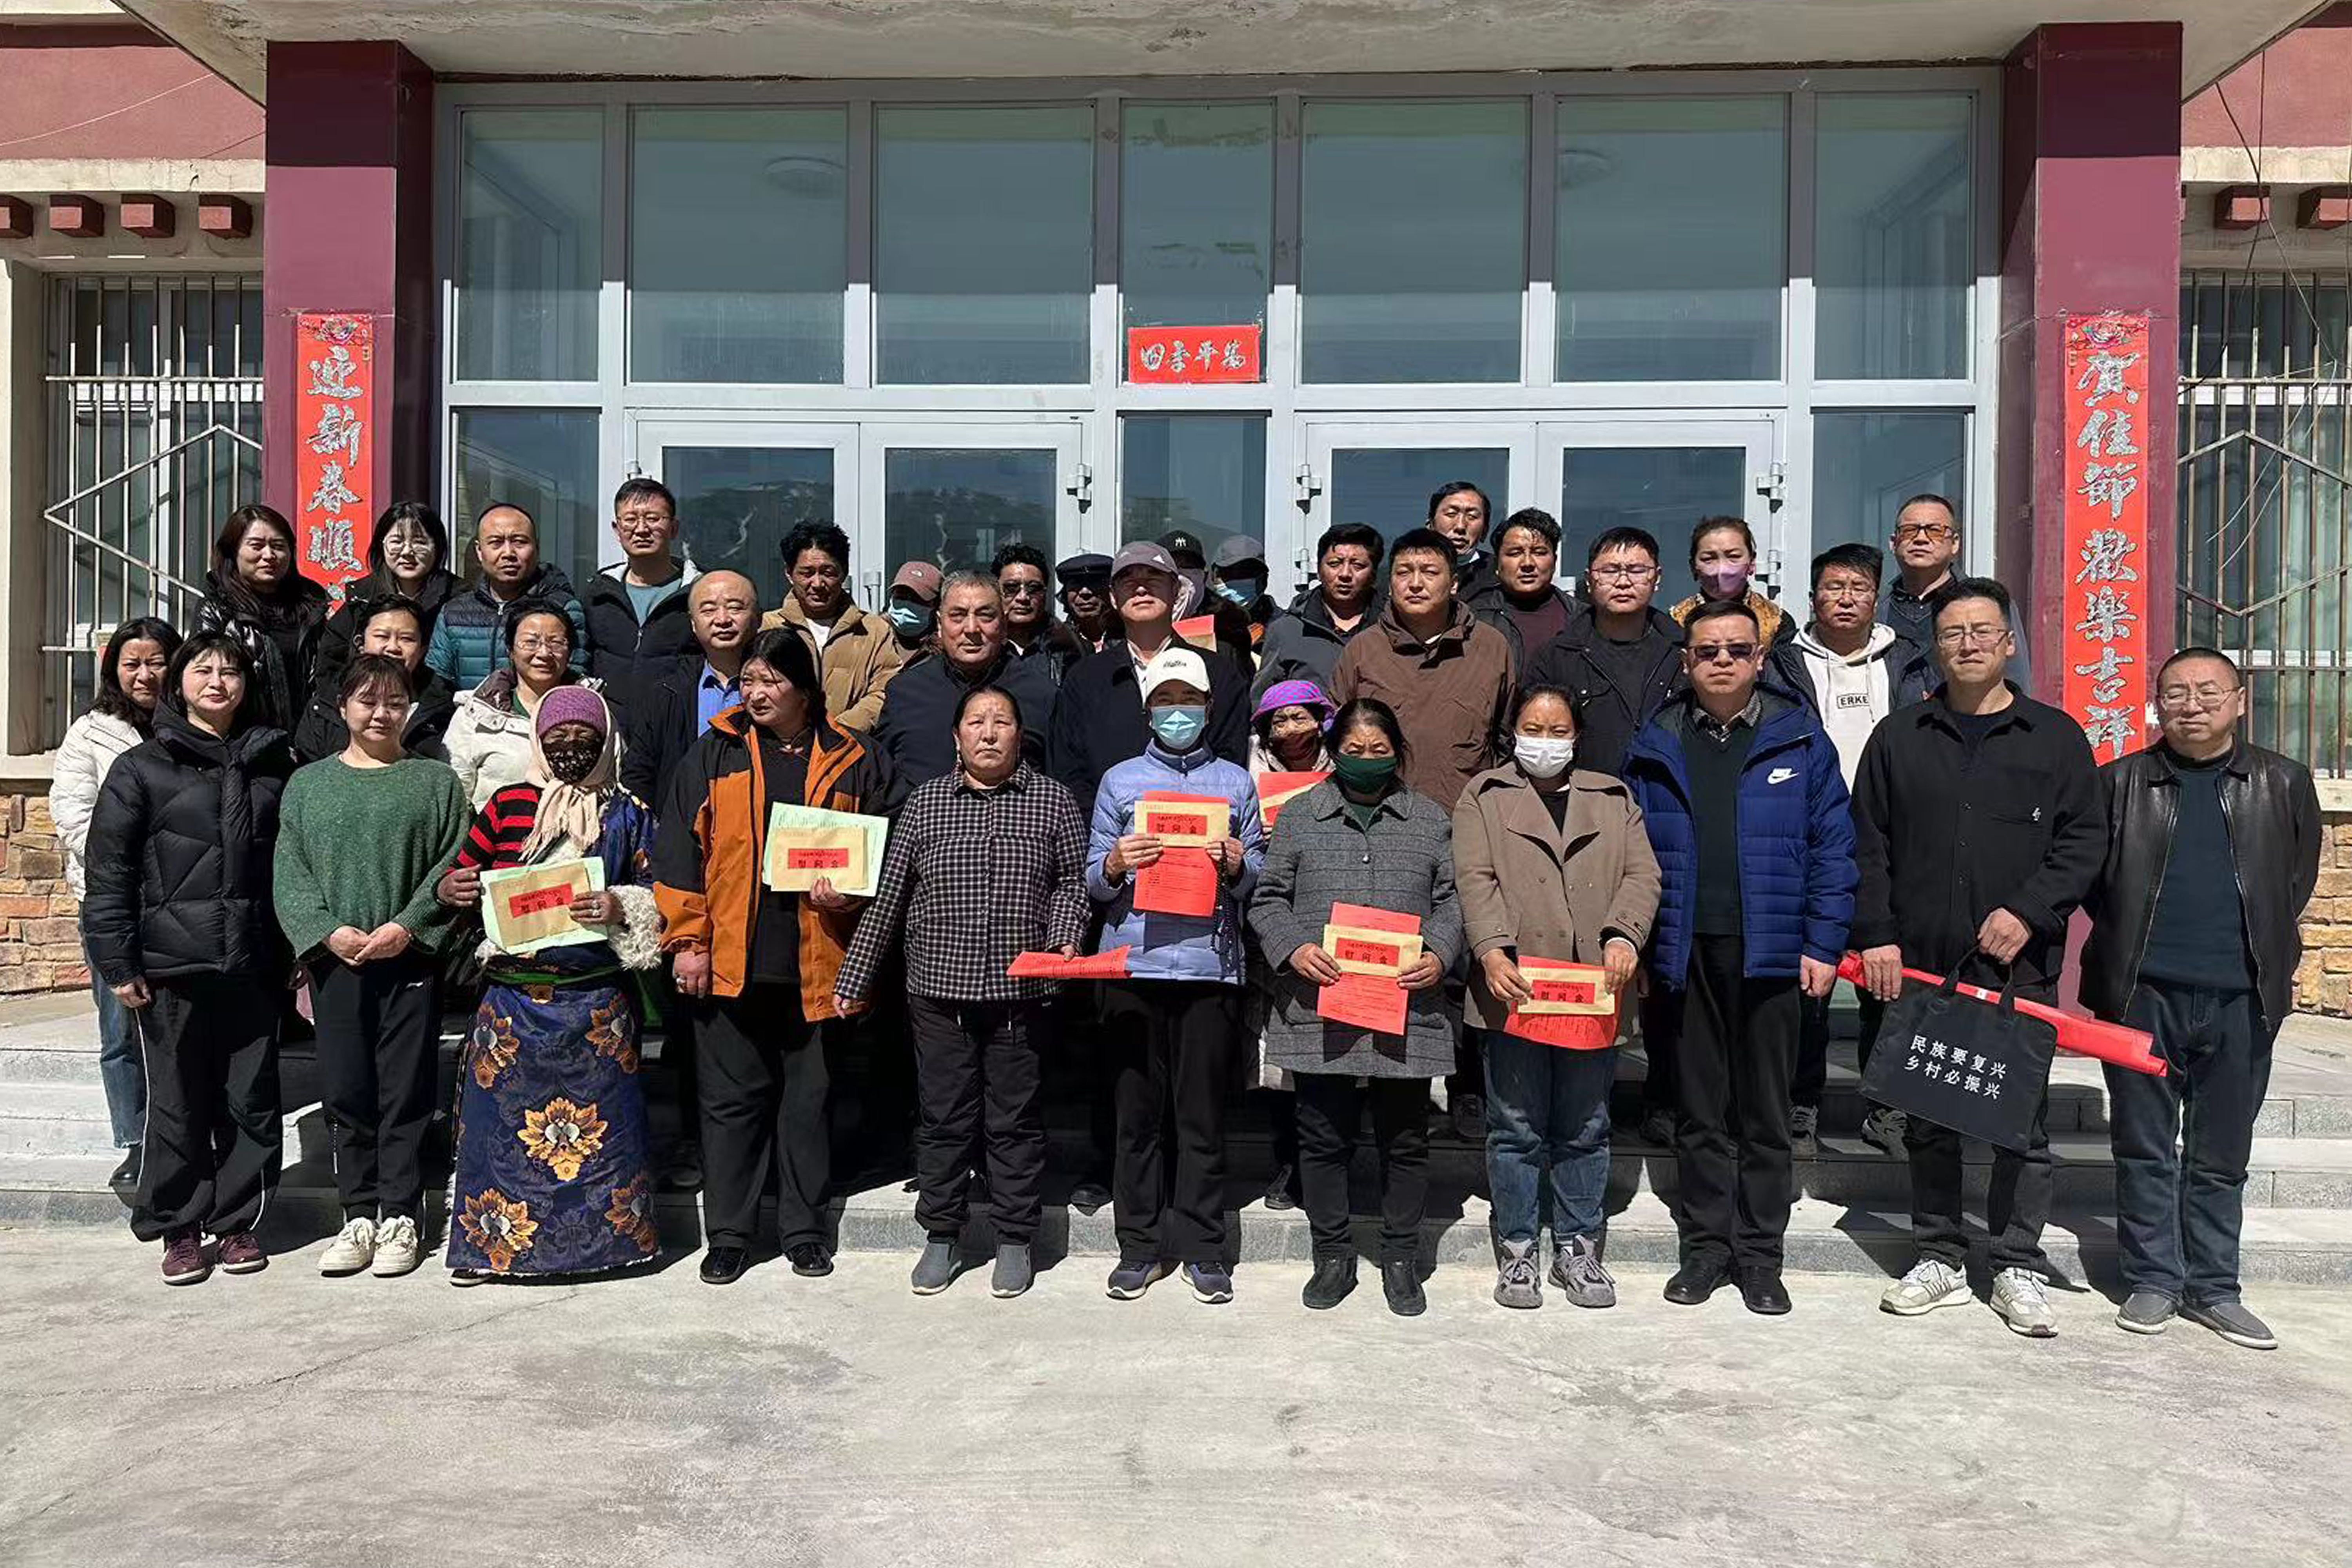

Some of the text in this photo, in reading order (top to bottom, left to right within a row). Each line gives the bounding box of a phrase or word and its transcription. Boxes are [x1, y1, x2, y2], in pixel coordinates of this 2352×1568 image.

[1840, 695, 1869, 705] ERKE
[1904, 1055, 2000, 1100] 乡村必振兴
[1910, 1034, 2007, 1079] 民族要复兴
